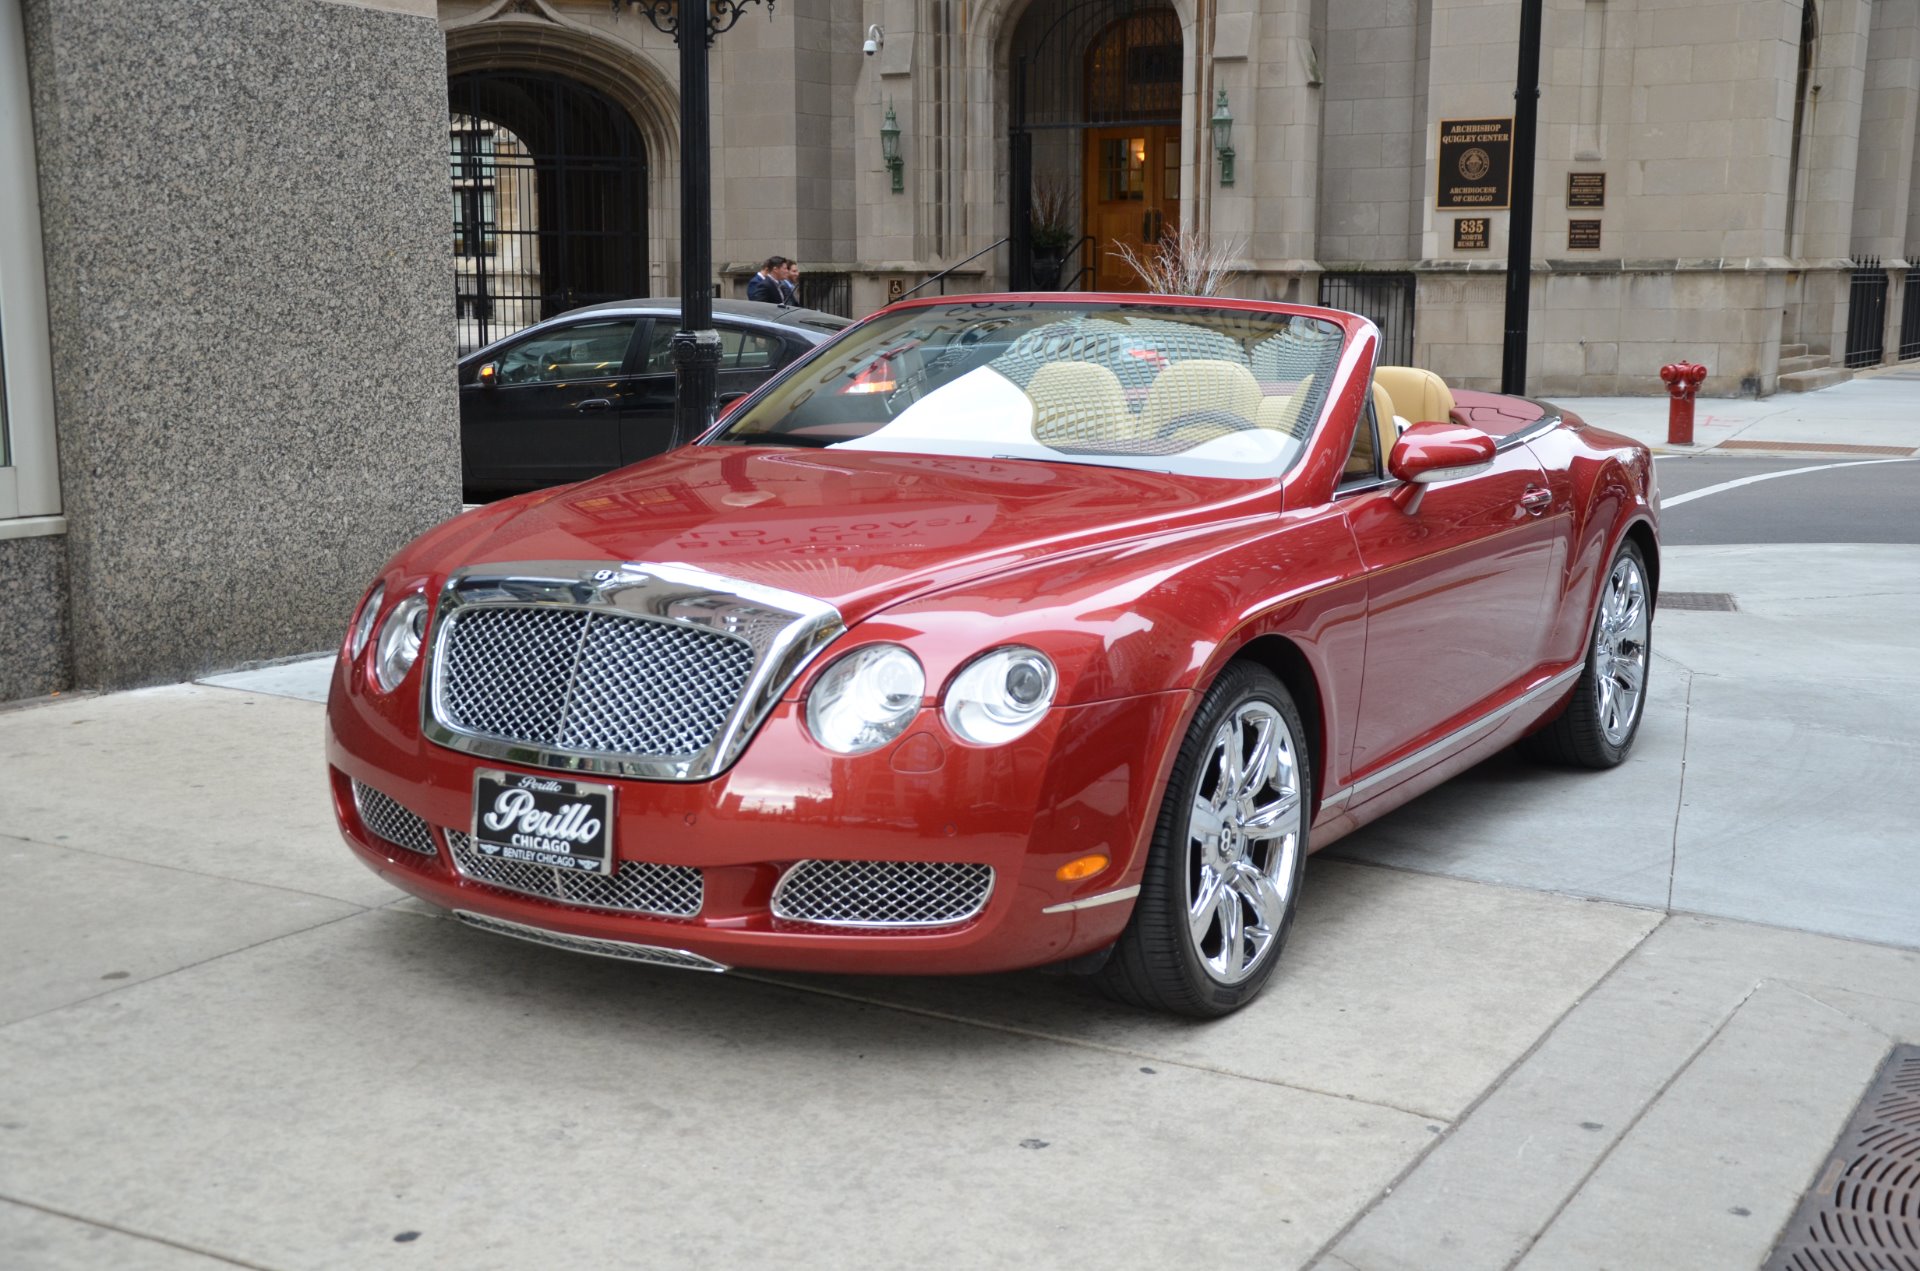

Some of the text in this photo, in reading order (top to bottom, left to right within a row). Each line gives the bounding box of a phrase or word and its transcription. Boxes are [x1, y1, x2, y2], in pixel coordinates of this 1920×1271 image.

[1450, 124, 1502, 133] ARCHBISHOP
[1442, 133, 1509, 144] QUIGLEY CENTER
[1449, 186, 1497, 194] ARCHDIOCESE
[1460, 220, 1484, 233] 835
[517, 776, 562, 792] Perillo
[483, 788, 601, 844] Perillo
[511, 833, 571, 854] CHICAGO
[502, 846, 576, 867] BENTLEY CHICAGO
